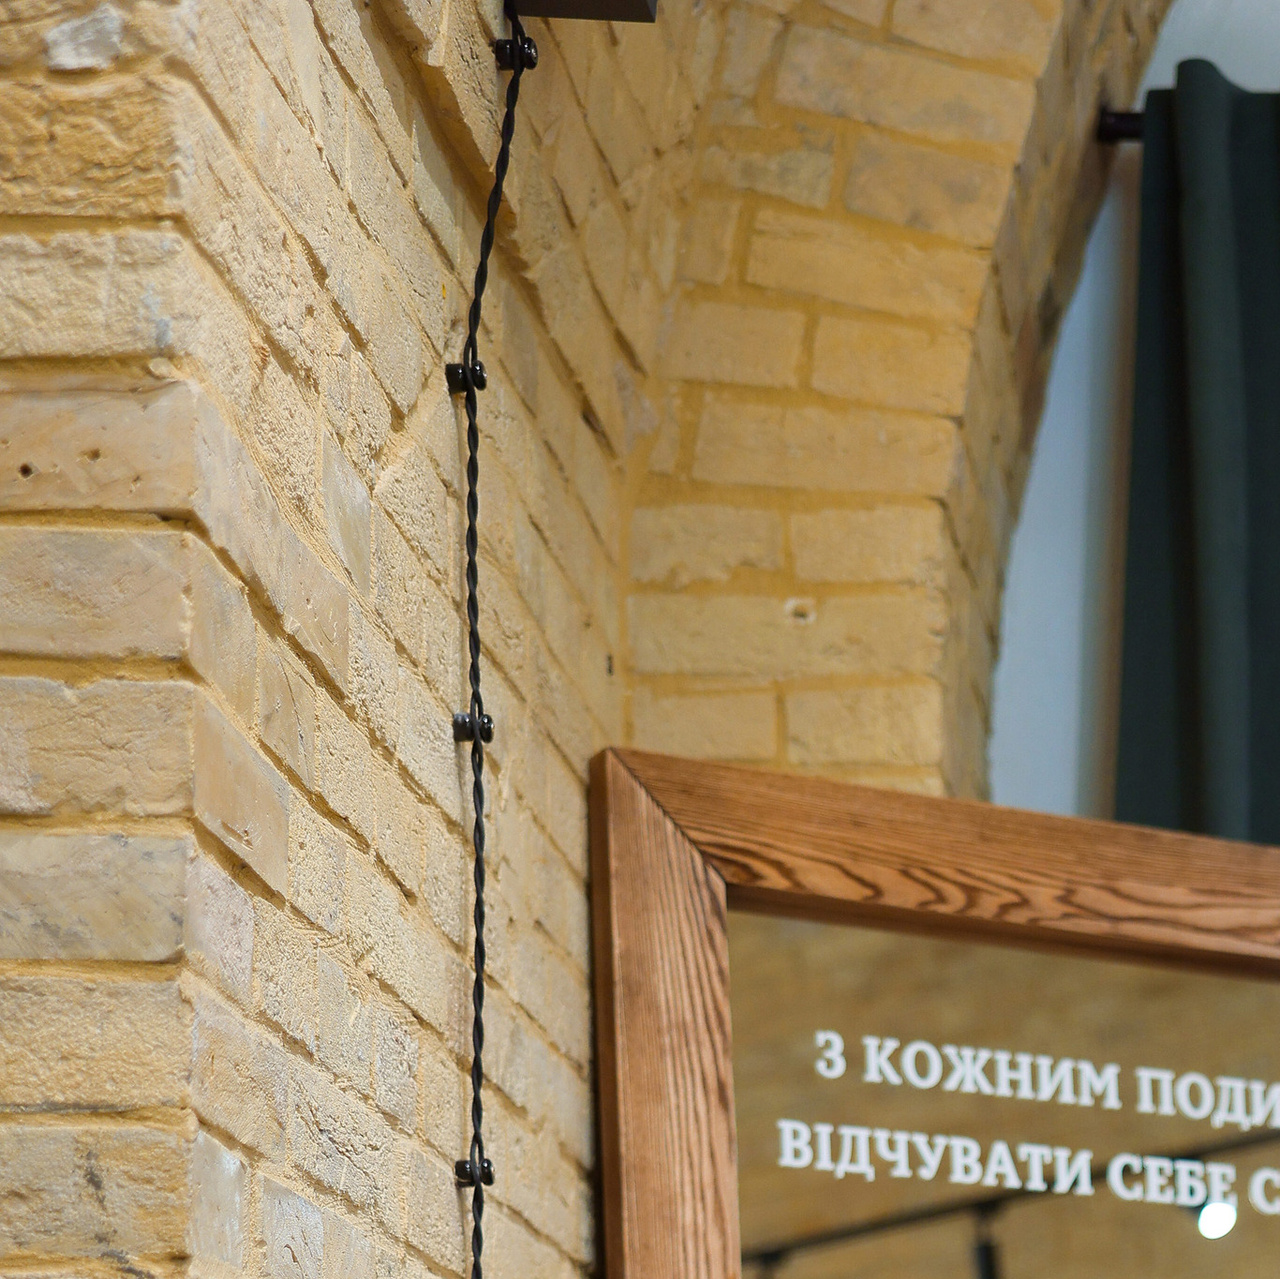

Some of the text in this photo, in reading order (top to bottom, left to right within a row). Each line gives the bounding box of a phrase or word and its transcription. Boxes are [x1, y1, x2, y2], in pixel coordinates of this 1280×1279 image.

[814, 1029, 847, 1079] З
[861, 1034, 1123, 1111] КОЖНИМ
[776, 1117, 1096, 1196] ВІДЧУВАТИ
[1106, 1151, 1238, 1208] СЕБЕ
